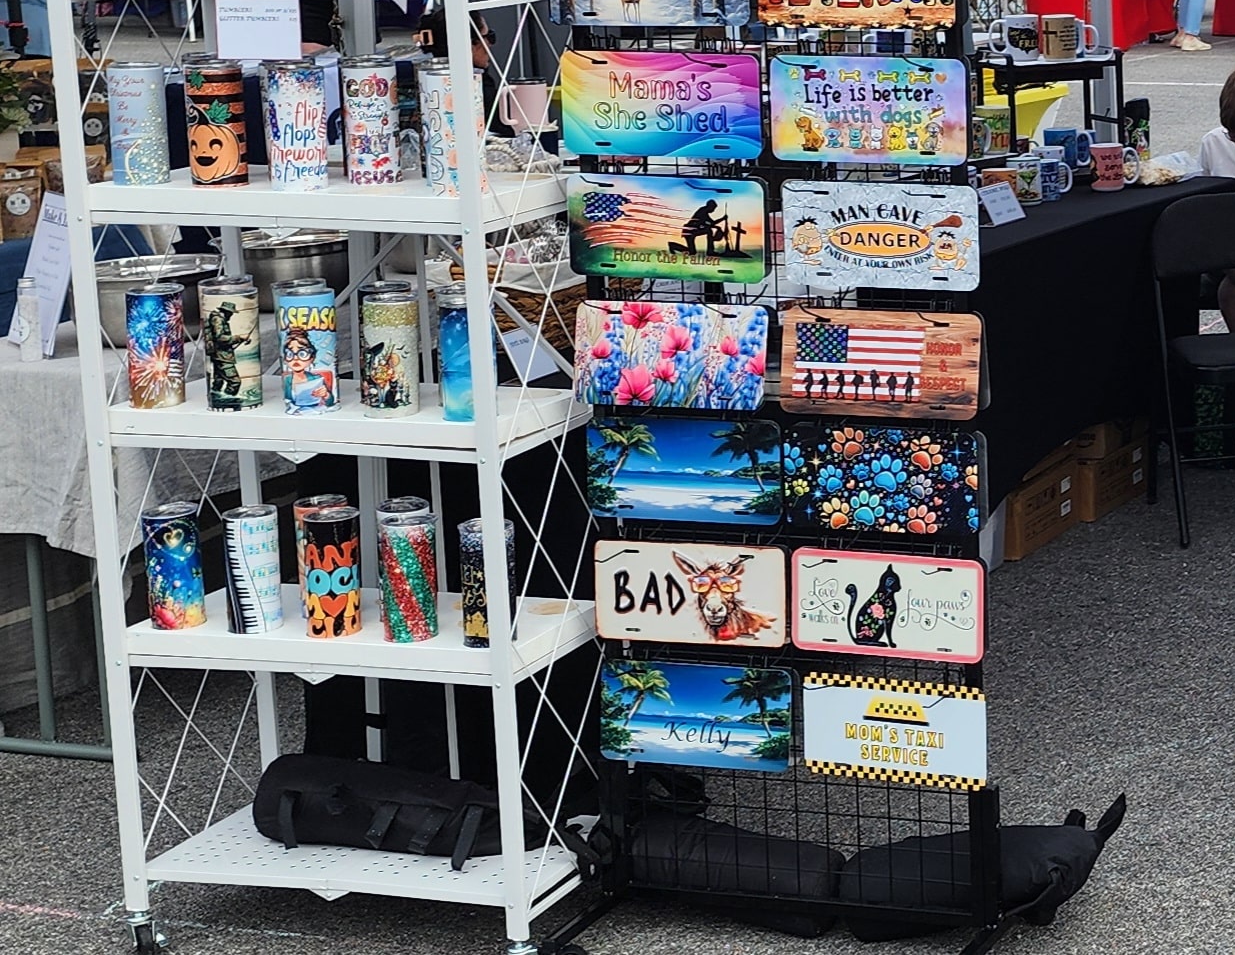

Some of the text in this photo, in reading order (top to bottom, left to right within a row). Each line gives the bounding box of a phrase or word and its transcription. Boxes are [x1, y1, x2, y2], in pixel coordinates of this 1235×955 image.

[346, 76, 389, 99] GOD
[608, 70, 713, 102] Mama's
[804, 83, 934, 105] Life is better
[294, 100, 319, 128] flip
[593, 102, 730, 134] She Shed
[824, 104, 922, 128] with dogs
[283, 124, 316, 149] flops
[830, 203, 924, 227] MAN CAVE
[839, 231, 921, 249] DANGER
[613, 248, 721, 266] Honor the Fallen
[891, 257, 913, 268] OWN
[287, 306, 336, 332] SEASO
[612, 570, 687, 616] BAD
[808, 577, 839, 600] Love
[660, 720, 732, 746] Kelly
[844, 722, 945, 749] MOM'S TAXI
[860, 744, 929, 767] SERVICE
